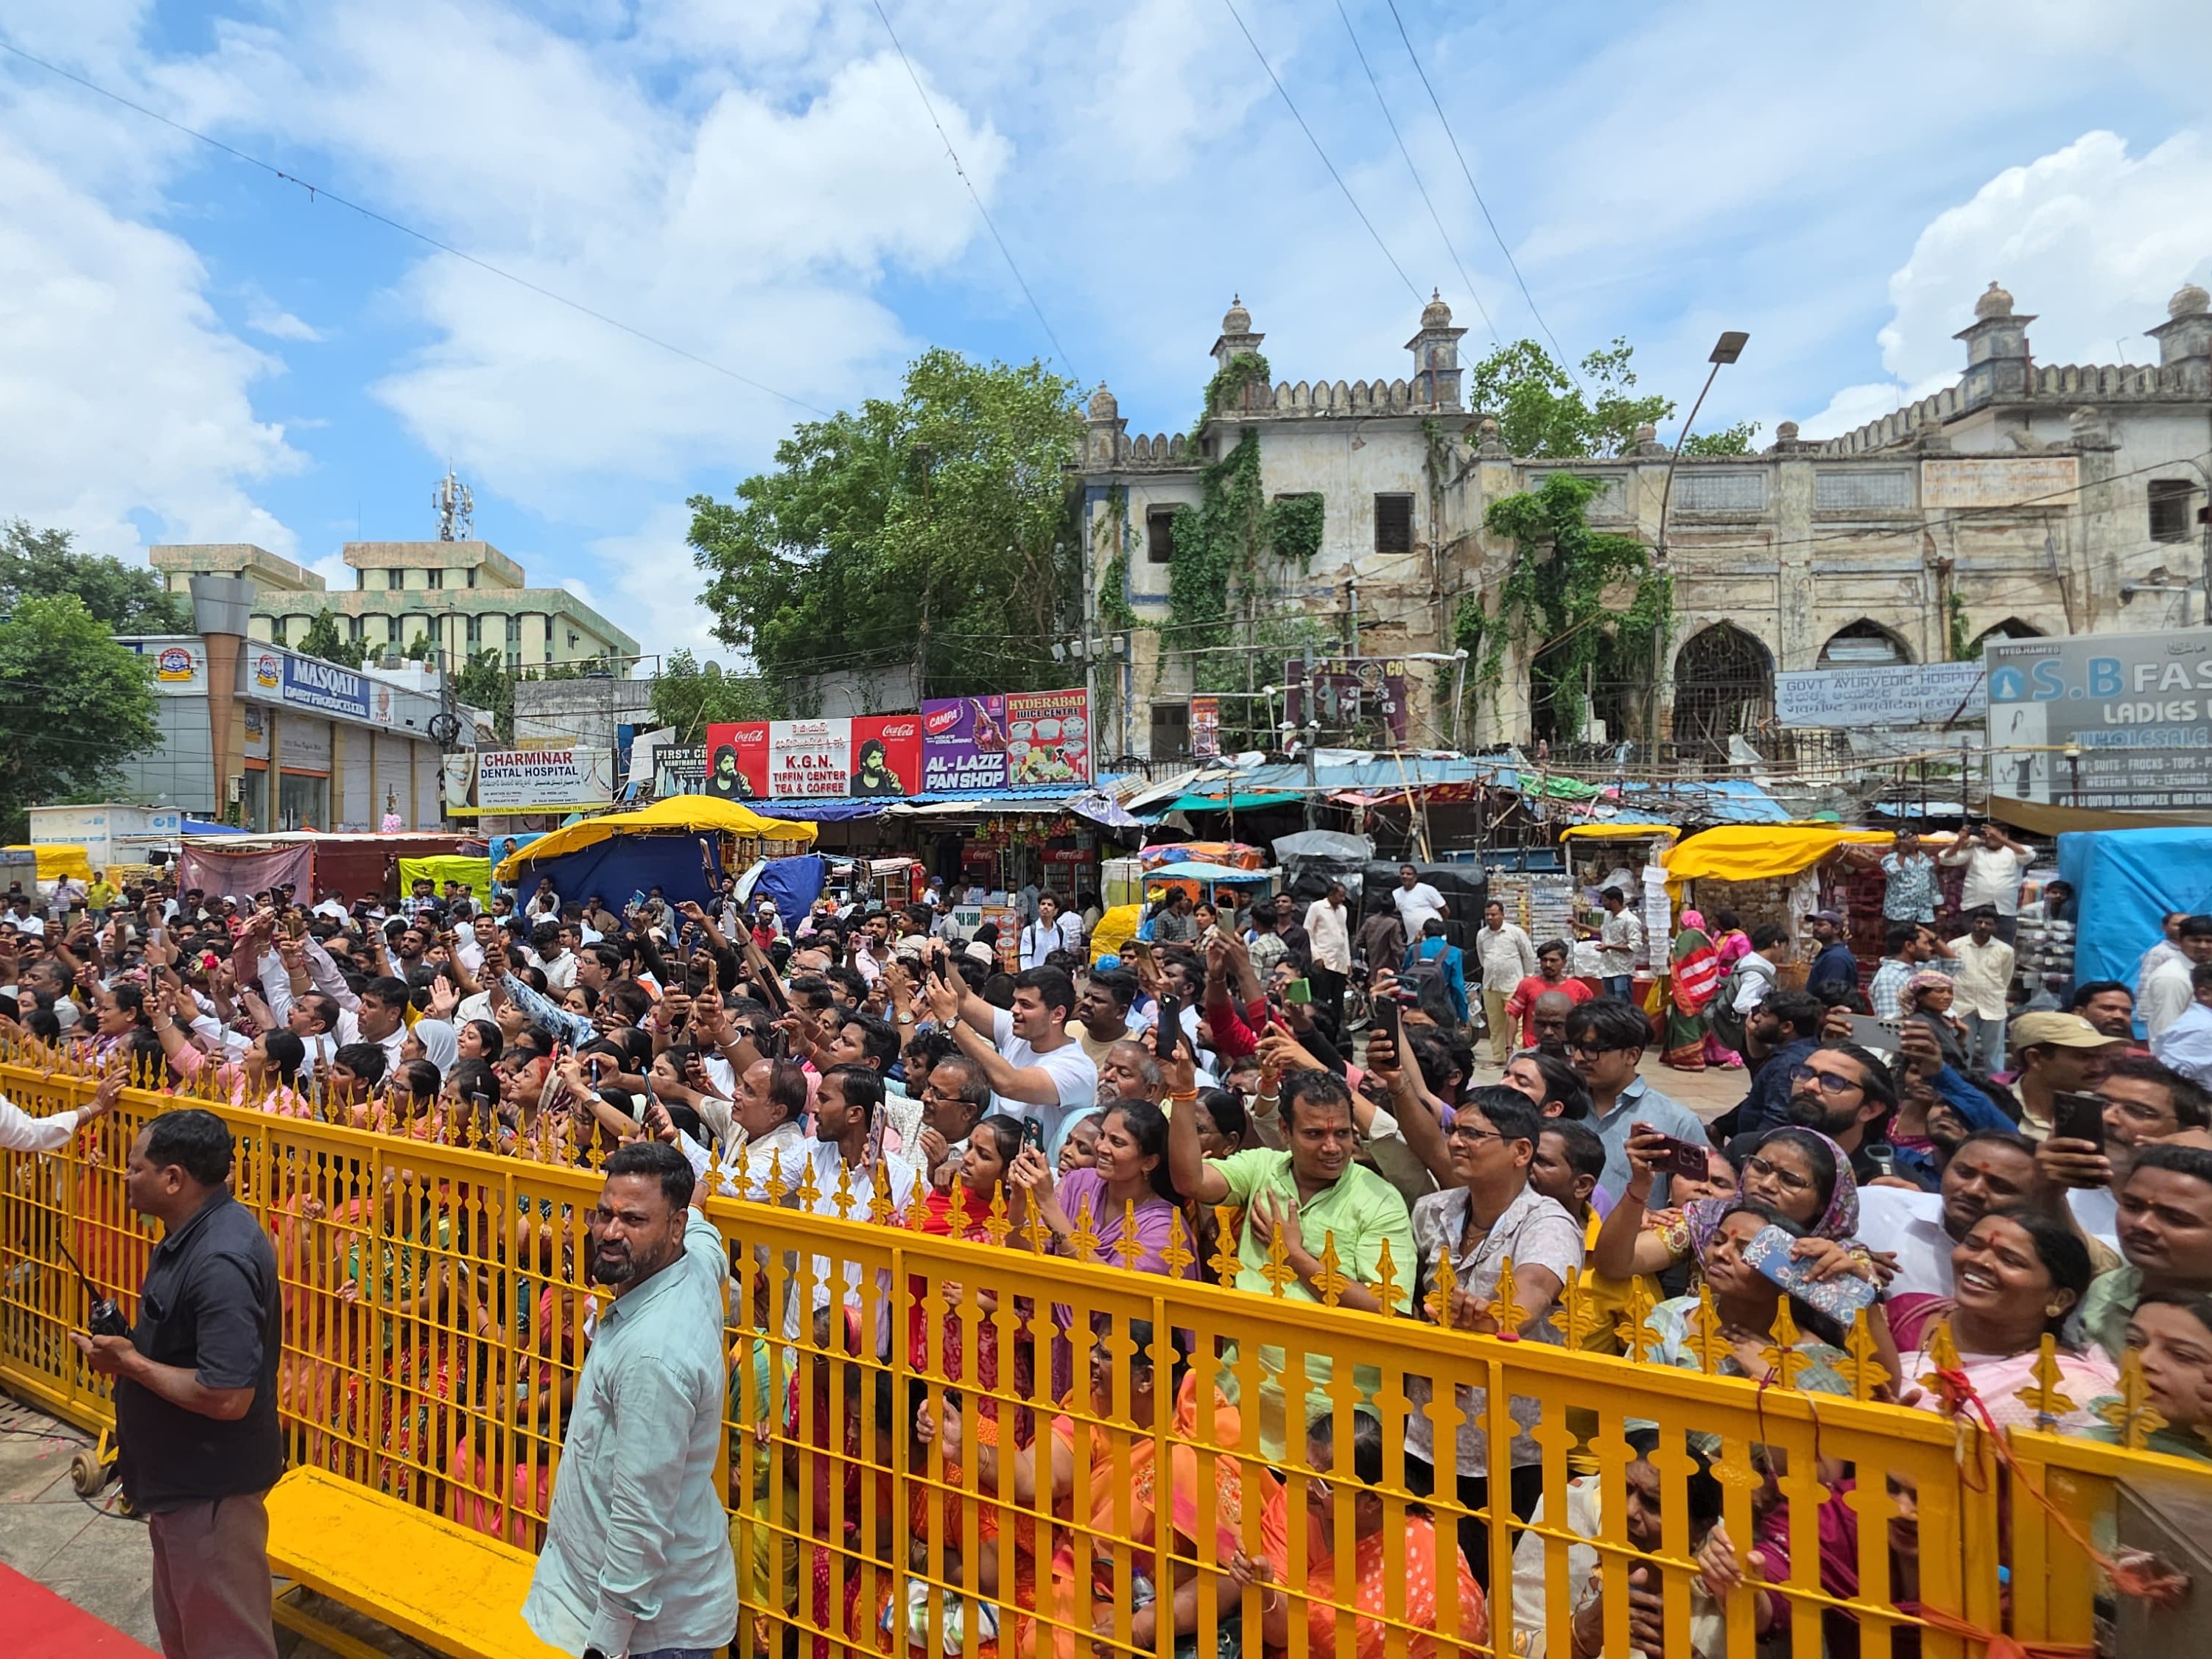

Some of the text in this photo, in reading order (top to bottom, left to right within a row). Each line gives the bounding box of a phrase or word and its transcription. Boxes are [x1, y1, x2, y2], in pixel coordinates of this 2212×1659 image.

[293, 658, 359, 698] MASQATI
[1787, 680, 1825, 692] GOVT
[1834, 674, 1913, 689] AYURVEDIC
[1008, 695, 1086, 711] HYDERABAD
[929, 709, 958, 729] CAMPA
[1016, 706, 1079, 719] JUICE CENTRE
[2103, 700, 2197, 725] LADIES
[484, 751, 573, 767] CHARMINAR
[656, 748, 690, 760] FIRST
[786, 754, 833, 768] K.G.N.
[2093, 760, 2119, 771] SUITS
[2128, 758, 2163, 771] FROCKS
[2172, 757, 2196, 769] TOPS
[481, 765, 579, 779] DENTAL HOSPITAL
[773, 770, 846, 782] TIFFIN CENTER
[775, 782, 845, 793] TEA & COFFEE
[925, 771, 1005, 790] PAN SHOP
[2085, 775, 2127, 788] WESTERN
[2114, 794, 2130, 807] SHA
[2131, 793, 2169, 807] COMPLEX
[2172, 792, 2194, 805] NEAR
[966, 912, 980, 926] SHOP
